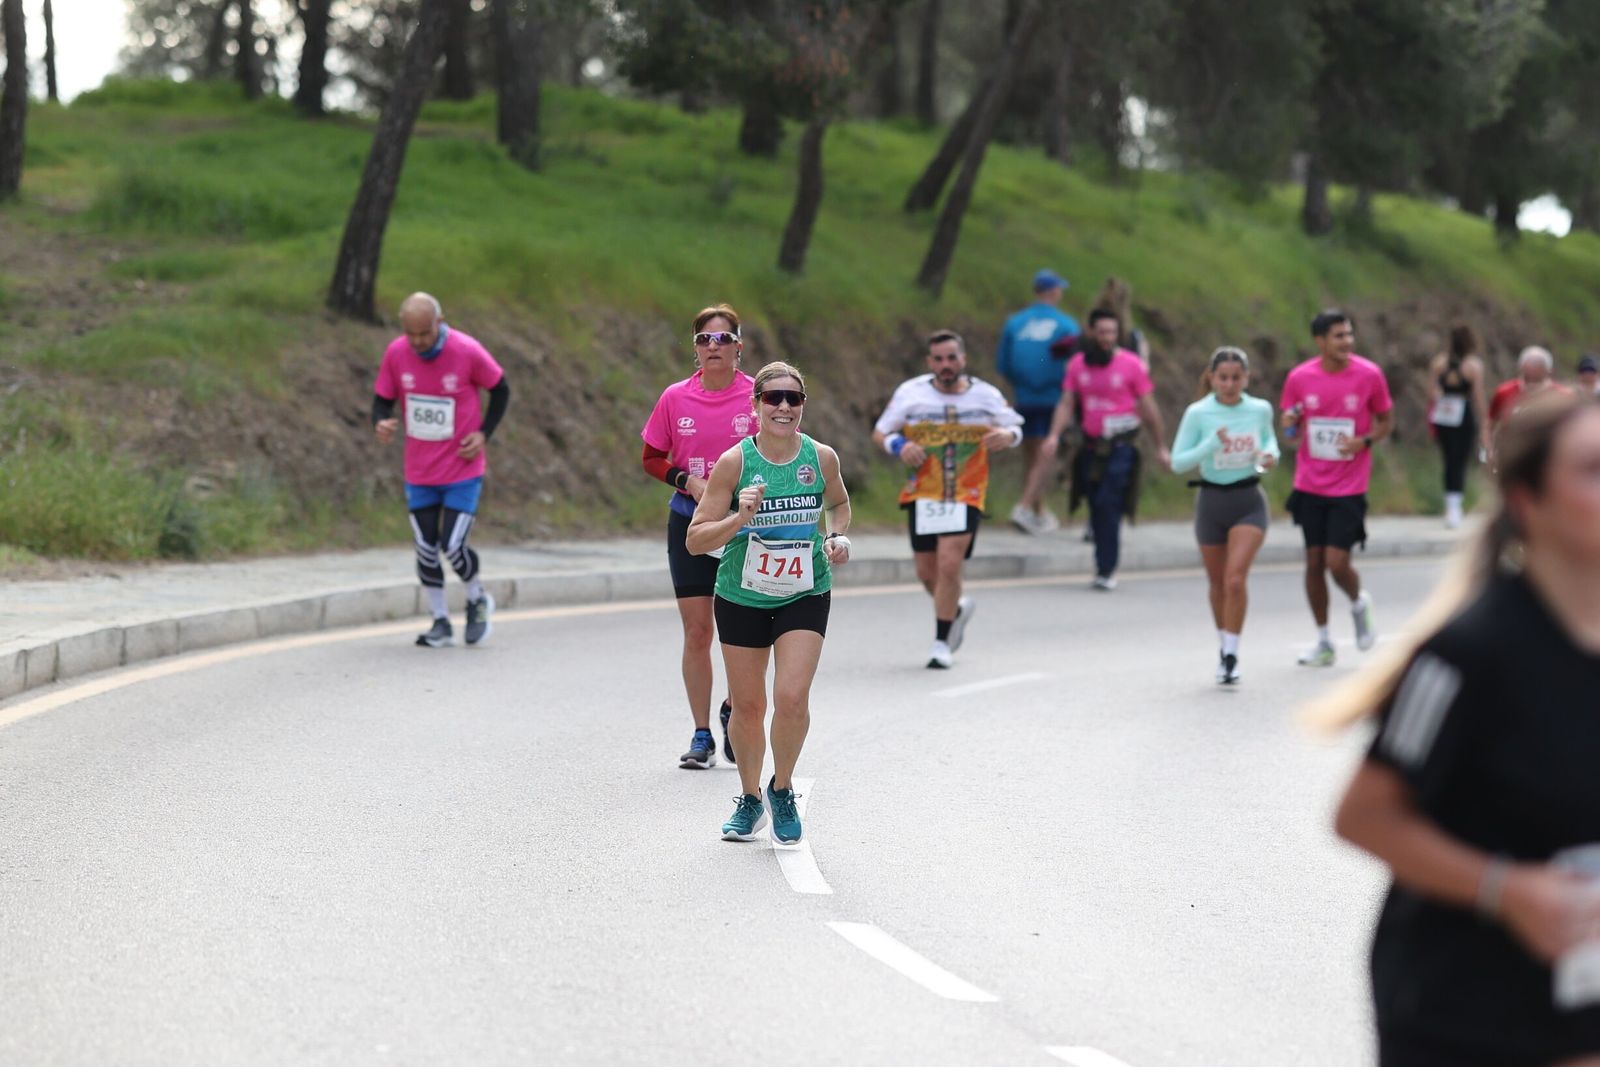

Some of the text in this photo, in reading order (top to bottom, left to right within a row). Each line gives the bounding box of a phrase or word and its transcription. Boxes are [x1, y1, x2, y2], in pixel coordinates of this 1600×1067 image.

[413, 407, 446, 426] 680
[758, 496, 817, 511] TLETISMO
[925, 502, 957, 518] 537
[745, 511, 821, 526] ORREMOLINO
[756, 553, 803, 579] 174
